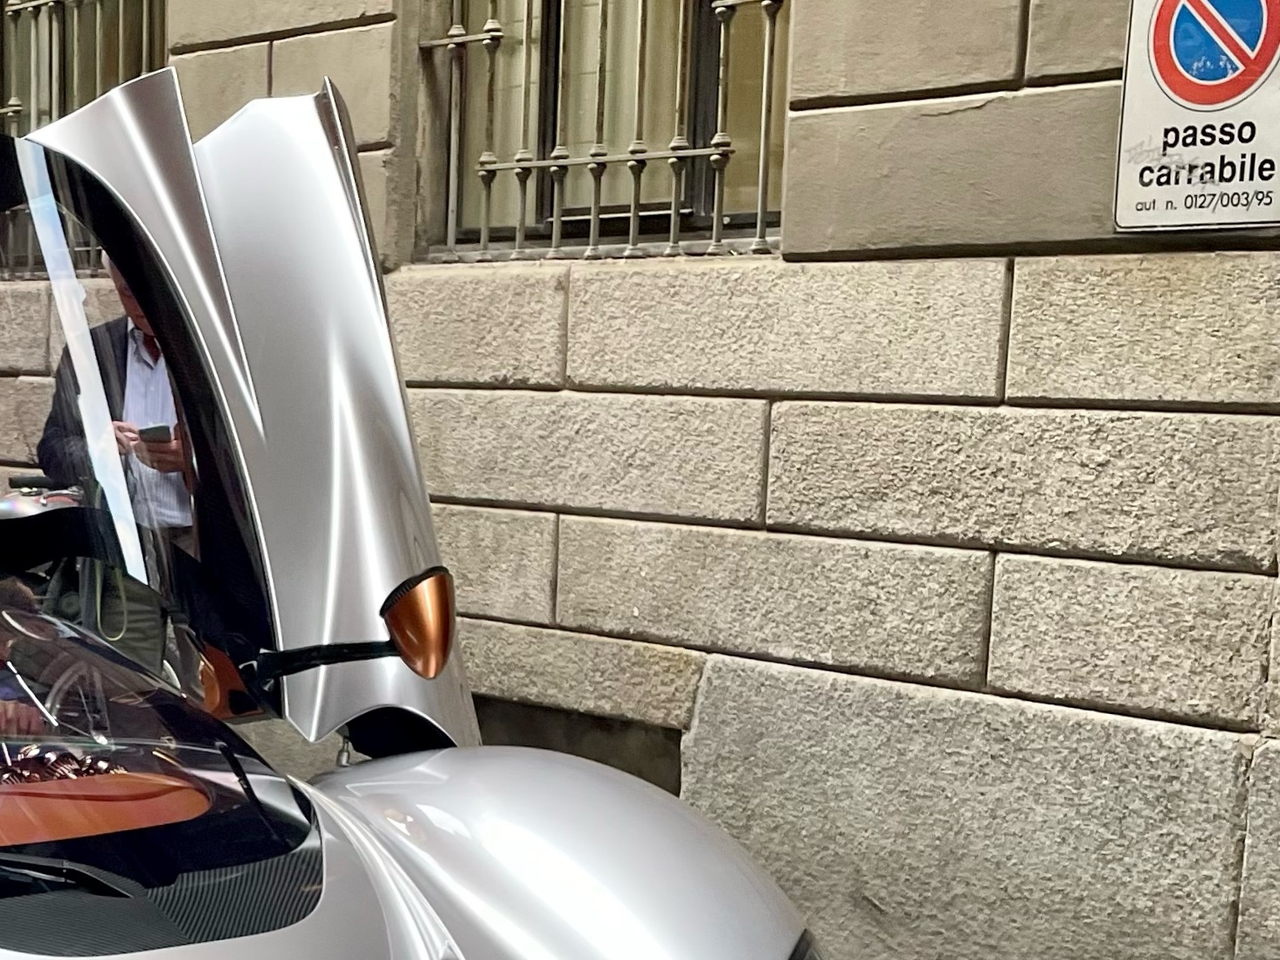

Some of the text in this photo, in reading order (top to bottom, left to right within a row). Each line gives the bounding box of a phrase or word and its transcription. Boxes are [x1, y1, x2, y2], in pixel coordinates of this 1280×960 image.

[1163, 121, 1256, 156] passo
[1138, 152, 1276, 188] carrabile
[1165, 199, 1178, 211] n.
[1183, 190, 1274, 213] 0127/003/95
